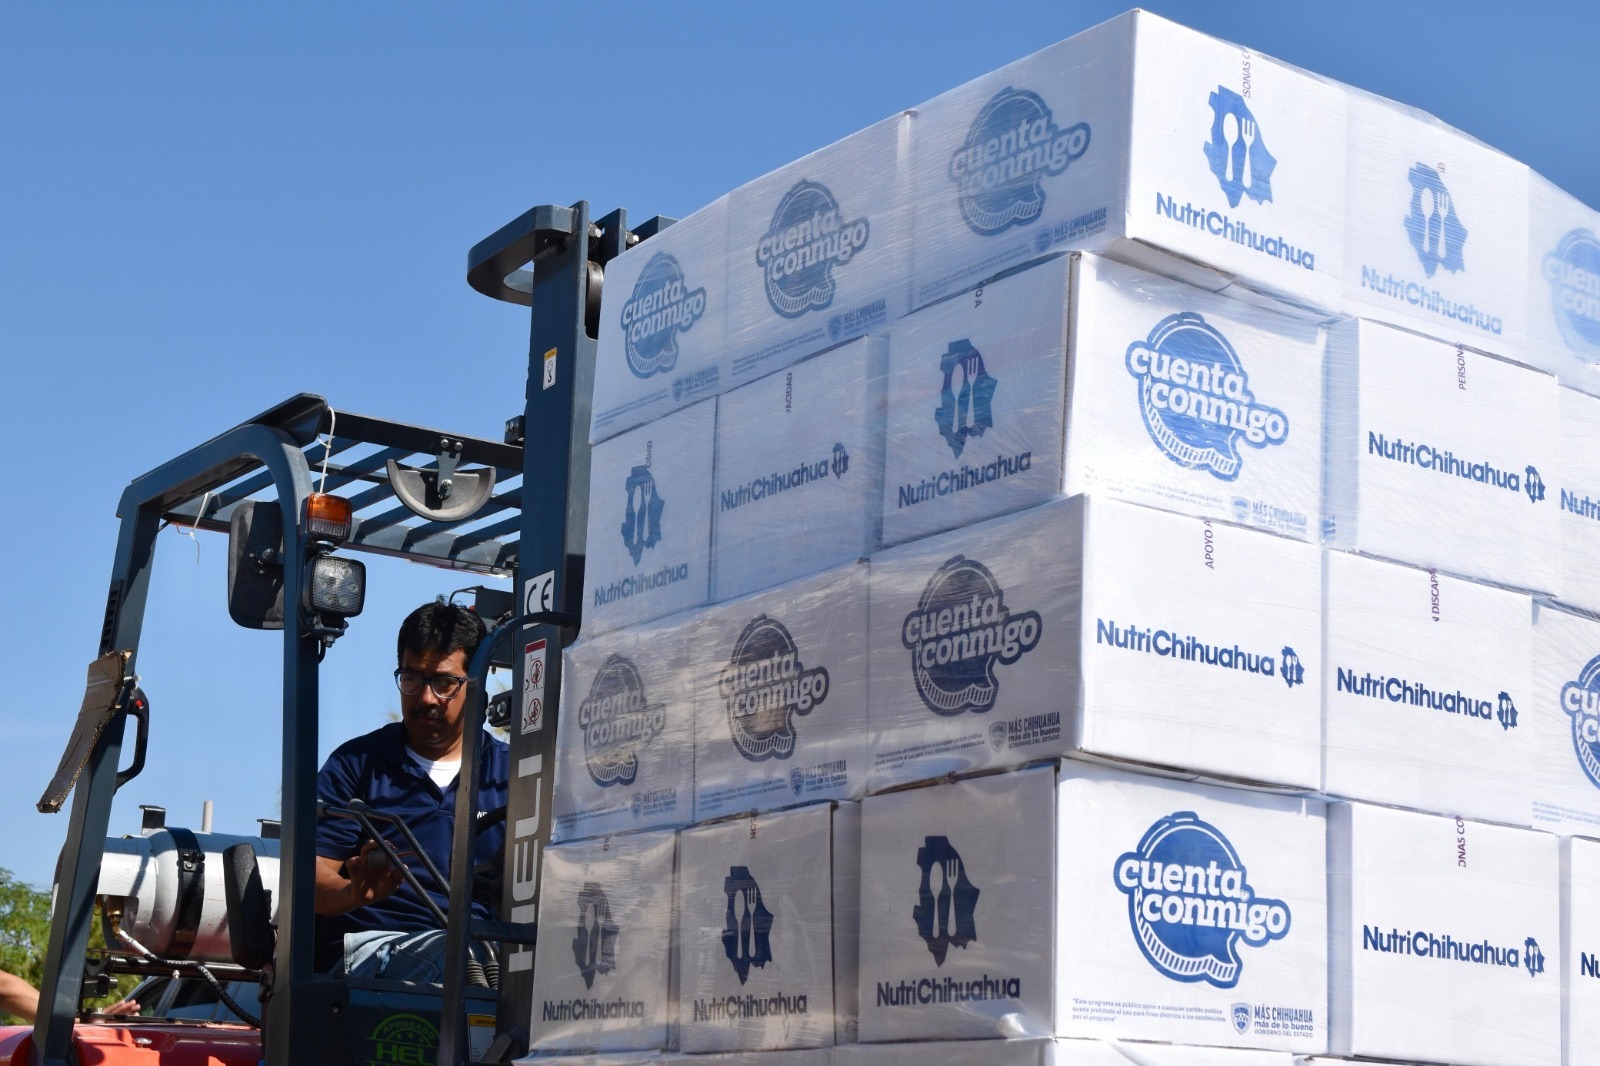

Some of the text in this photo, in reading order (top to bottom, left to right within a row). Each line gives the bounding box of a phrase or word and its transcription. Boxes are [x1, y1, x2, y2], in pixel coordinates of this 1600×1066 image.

[953, 117, 1049, 172] cuenta
[970, 128, 1087, 192] conmigo
[758, 209, 838, 260] cuenta
[771, 222, 866, 281] conmigo
[1156, 192, 1315, 271] NutriChihuahua
[623, 279, 683, 325] cuenta
[631, 291, 703, 343] conmigo
[1361, 264, 1503, 336] NutriChihuahua
[1130, 347, 1244, 401] cuenta
[1150, 382, 1285, 443] conmigo
[899, 452, 1031, 509] NutriChihuahua
[1369, 430, 1520, 492] NutriChihuahua
[721, 459, 828, 512] NutriChihuahua
[1203, 519, 1215, 570] APOYO A
[594, 563, 688, 607] NutriChihuahua
[905, 595, 1001, 642] cuenta
[921, 616, 1038, 669] conmigo
[1097, 618, 1275, 676] NutriChihuahua
[720, 651, 796, 692] cuenta
[735, 671, 827, 718] conmigo
[1337, 666, 1492, 720] NutriChihuahua
[580, 689, 642, 723] cuenta
[1008, 711, 1060, 735] MÁS CHIHUAHUA
[1564, 687, 1600, 717] cu
[590, 705, 665, 748] conmigo
[508, 753, 543, 973] HELI
[1119, 859, 1243, 900] cuenta
[1142, 893, 1286, 942] conmigo
[1363, 925, 1519, 967] NutriChihuahua
[542, 998, 645, 1022] NutriChihuahua
[694, 992, 807, 1022] NutriChihuahua
[877, 975, 1020, 1007] NutriChihuahua
[1254, 1003, 1313, 1023] MÁS CHIHUAHUA
[384, 1020, 436, 1039] APROBADO
[1254, 1020, 1313, 1031] más de lo bueno
[1254, 1028, 1281, 1036] GOBIERNO
